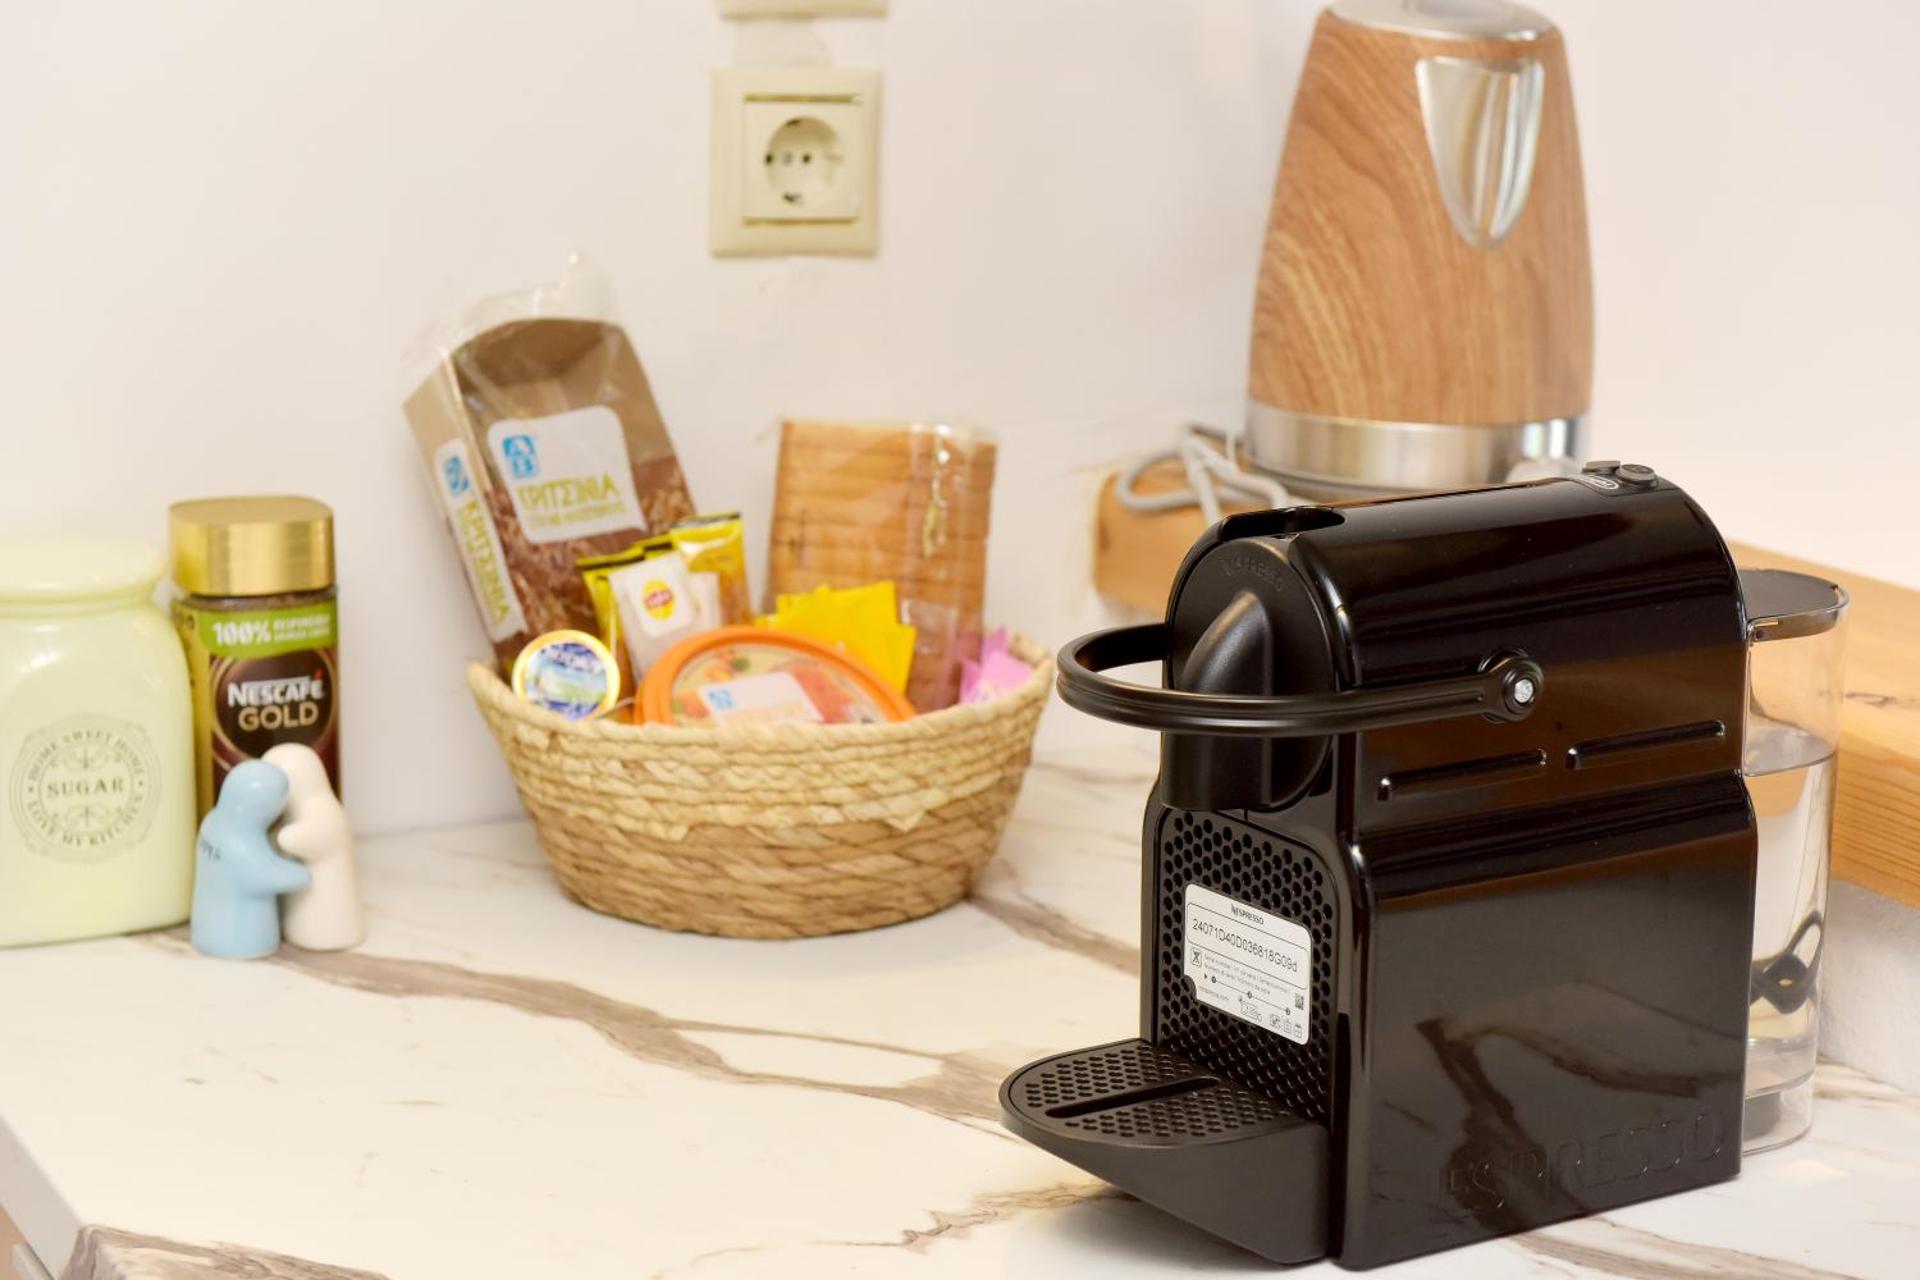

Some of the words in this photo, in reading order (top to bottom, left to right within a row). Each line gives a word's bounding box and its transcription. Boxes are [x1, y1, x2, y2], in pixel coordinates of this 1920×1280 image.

[211, 620, 272, 647] 100%
[237, 700, 320, 733] GOLD
[46, 776, 124, 799] SUGAR
